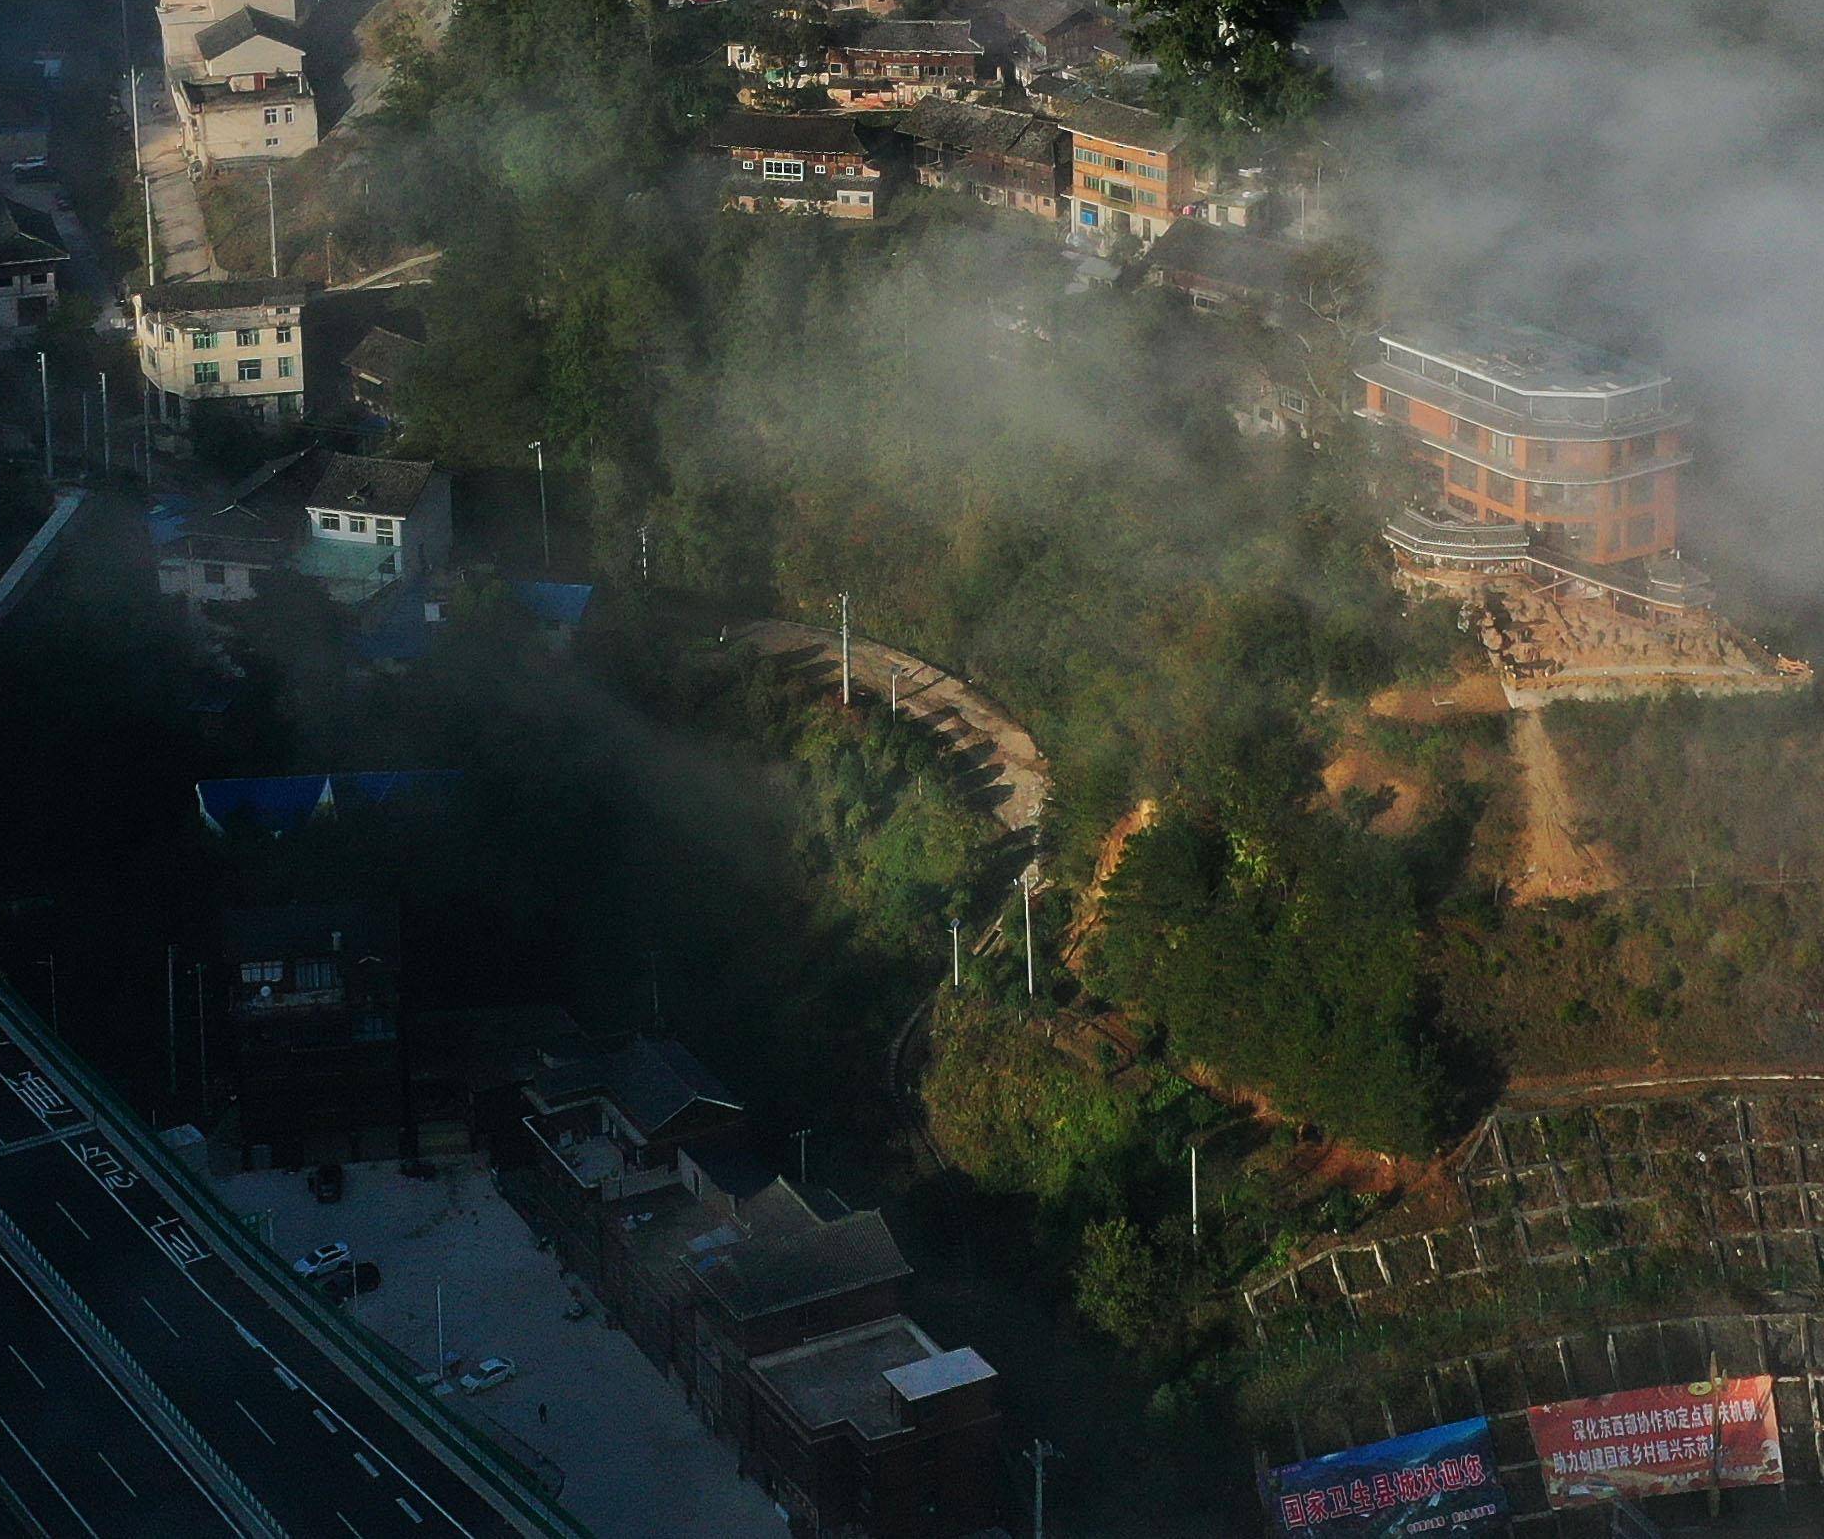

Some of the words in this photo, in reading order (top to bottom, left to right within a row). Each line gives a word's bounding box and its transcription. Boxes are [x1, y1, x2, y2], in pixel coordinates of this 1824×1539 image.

[1279, 1453, 1487, 1531] 国家卫生县城欢迎您
